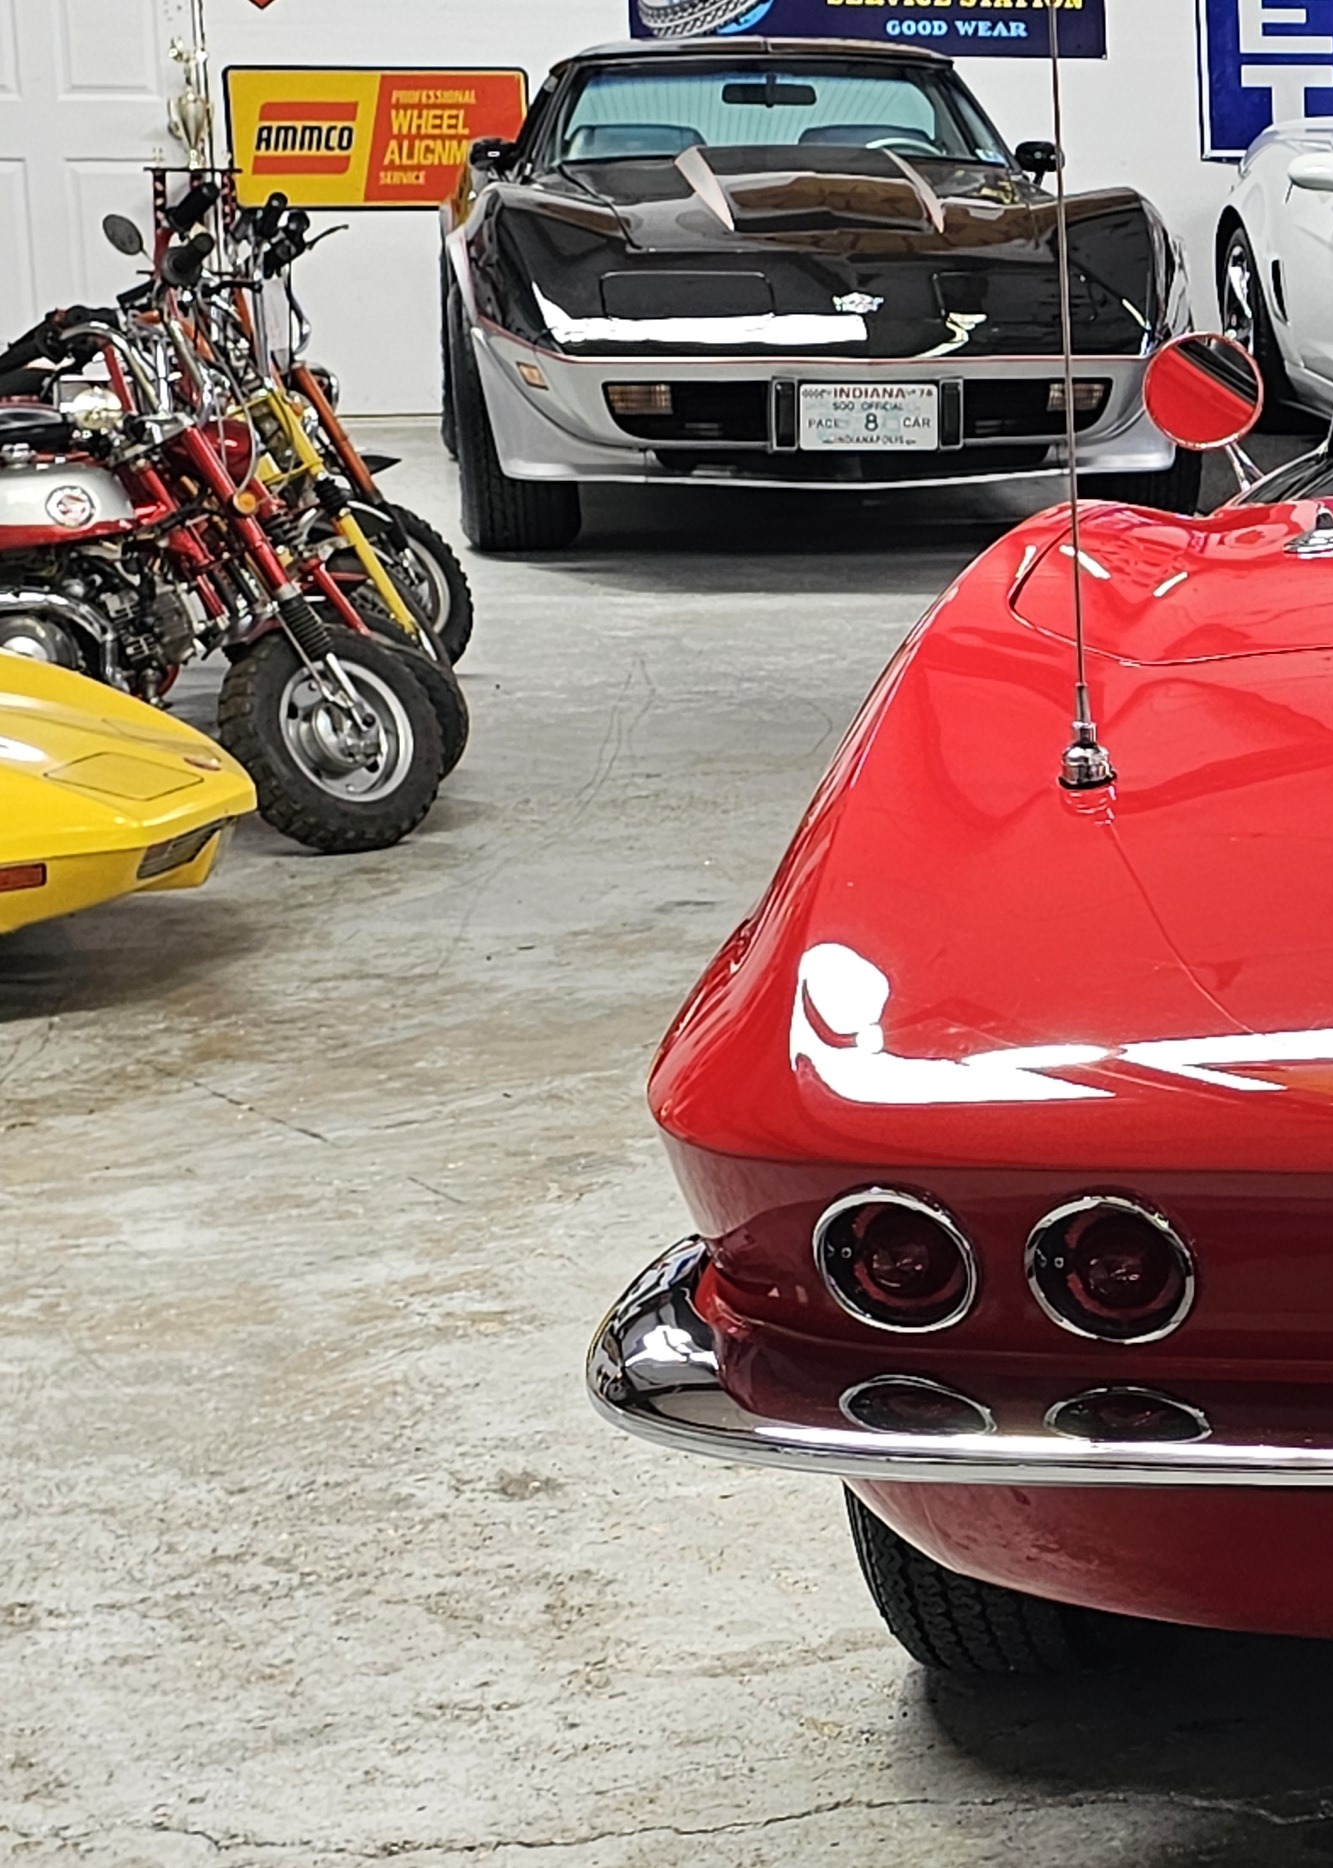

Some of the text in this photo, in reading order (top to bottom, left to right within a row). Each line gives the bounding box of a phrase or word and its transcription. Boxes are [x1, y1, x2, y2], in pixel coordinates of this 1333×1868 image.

[886, 20, 1028, 37] GOOD WEAR
[391, 89, 477, 104] PROFESSIONAL
[391, 109, 470, 135] WHEEL
[255, 125, 354, 151] AMMCO
[833, 387, 906, 399] INDIANA
[860, 401, 903, 412] OFFICIAL
[864, 412, 878, 432] 8
[902, 417, 931, 428] CAR
